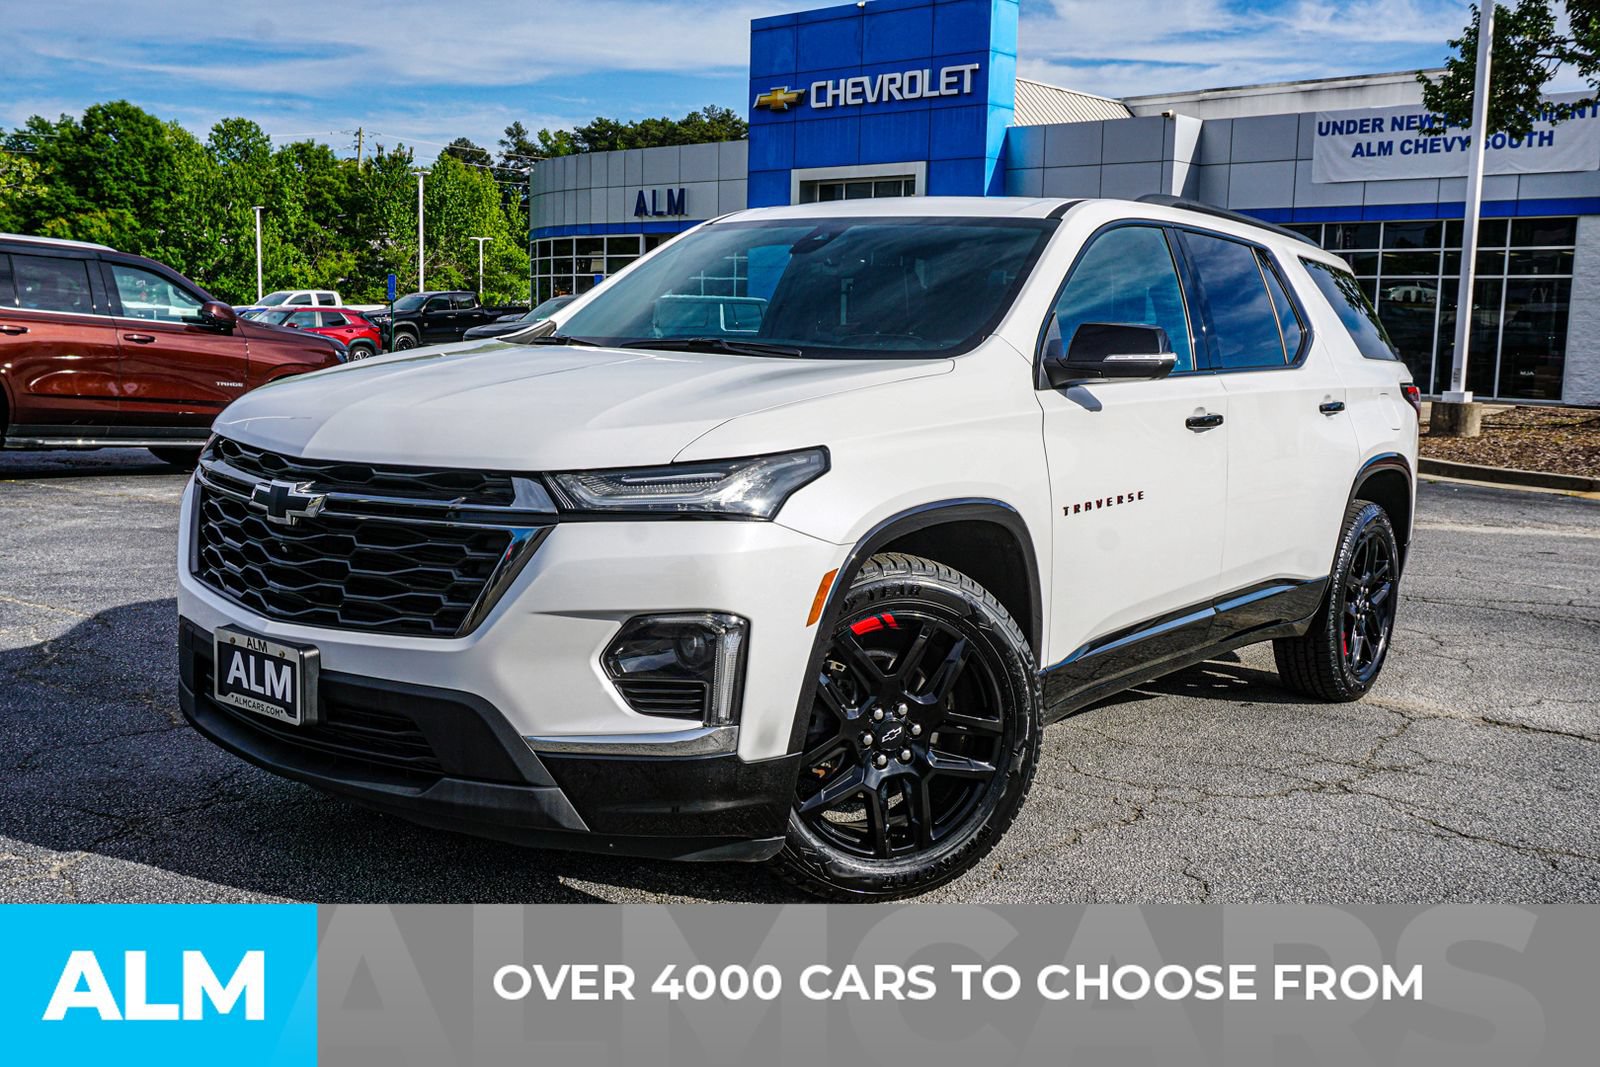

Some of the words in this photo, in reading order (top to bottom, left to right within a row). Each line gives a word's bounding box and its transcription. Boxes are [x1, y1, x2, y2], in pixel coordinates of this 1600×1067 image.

[811, 63, 979, 109] CHEVROLET
[1318, 117, 1384, 136] UNDER
[1391, 113, 1437, 132] NEW
[1352, 140, 1393, 158] ALM
[1400, 135, 1472, 155] CHEVY
[634, 188, 688, 217] ALM
[1063, 491, 1144, 516] TRAVERSE
[246, 637, 268, 653] ALM
[226, 650, 292, 704] ALM
